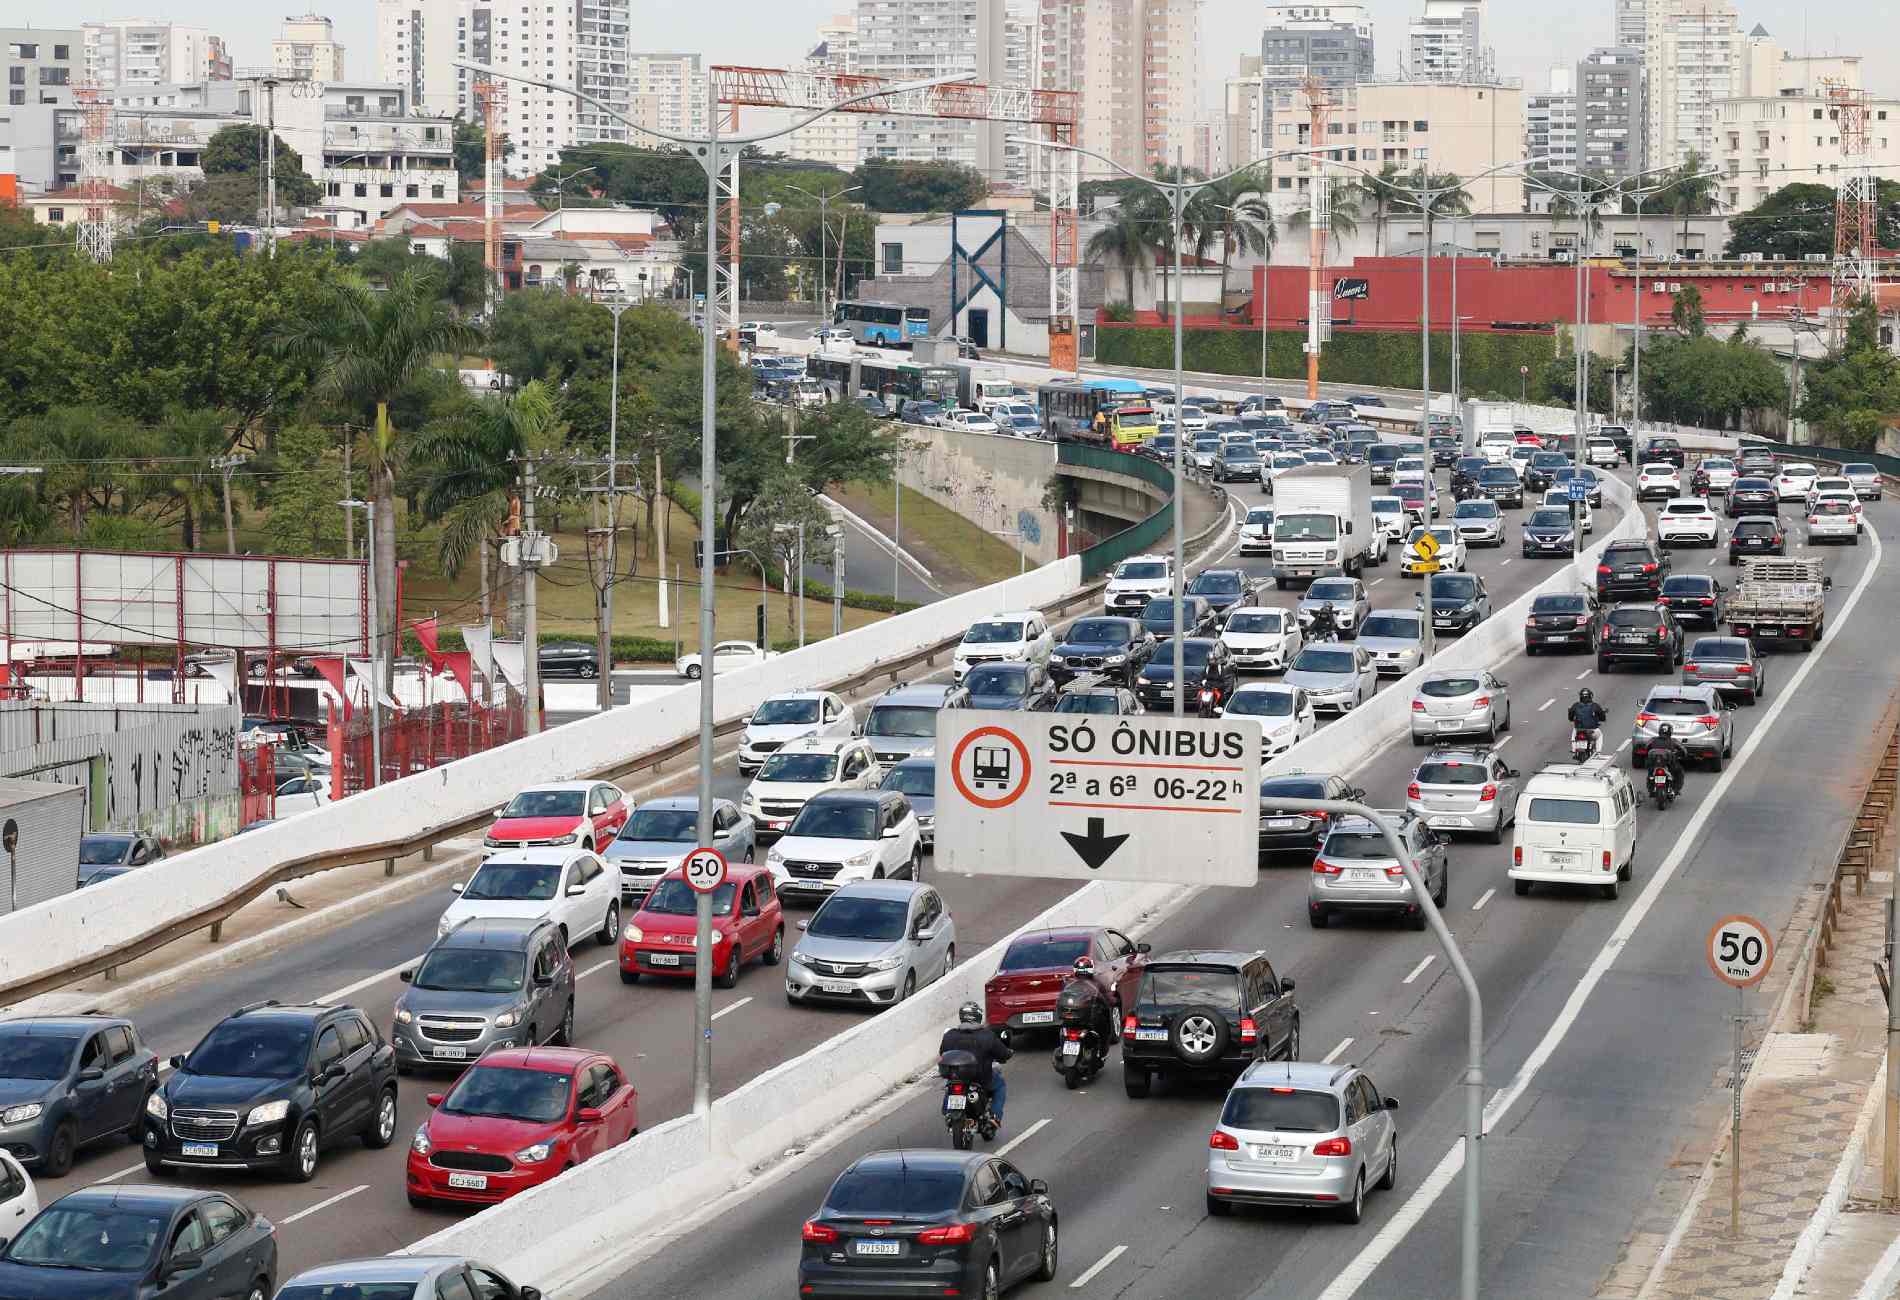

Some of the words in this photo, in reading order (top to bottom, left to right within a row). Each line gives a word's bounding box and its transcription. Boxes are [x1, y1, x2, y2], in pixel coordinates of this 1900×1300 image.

[1048, 719, 1096, 753] SÓ
[1112, 721, 1244, 759] ÔNIBUS
[1049, 772, 1077, 795] 2ª
[1086, 779, 1100, 796] a
[1109, 775, 1137, 797] 6ª
[690, 858, 718, 877] 50
[1719, 931, 1763, 966] 50
[1727, 966, 1750, 977] km/h
